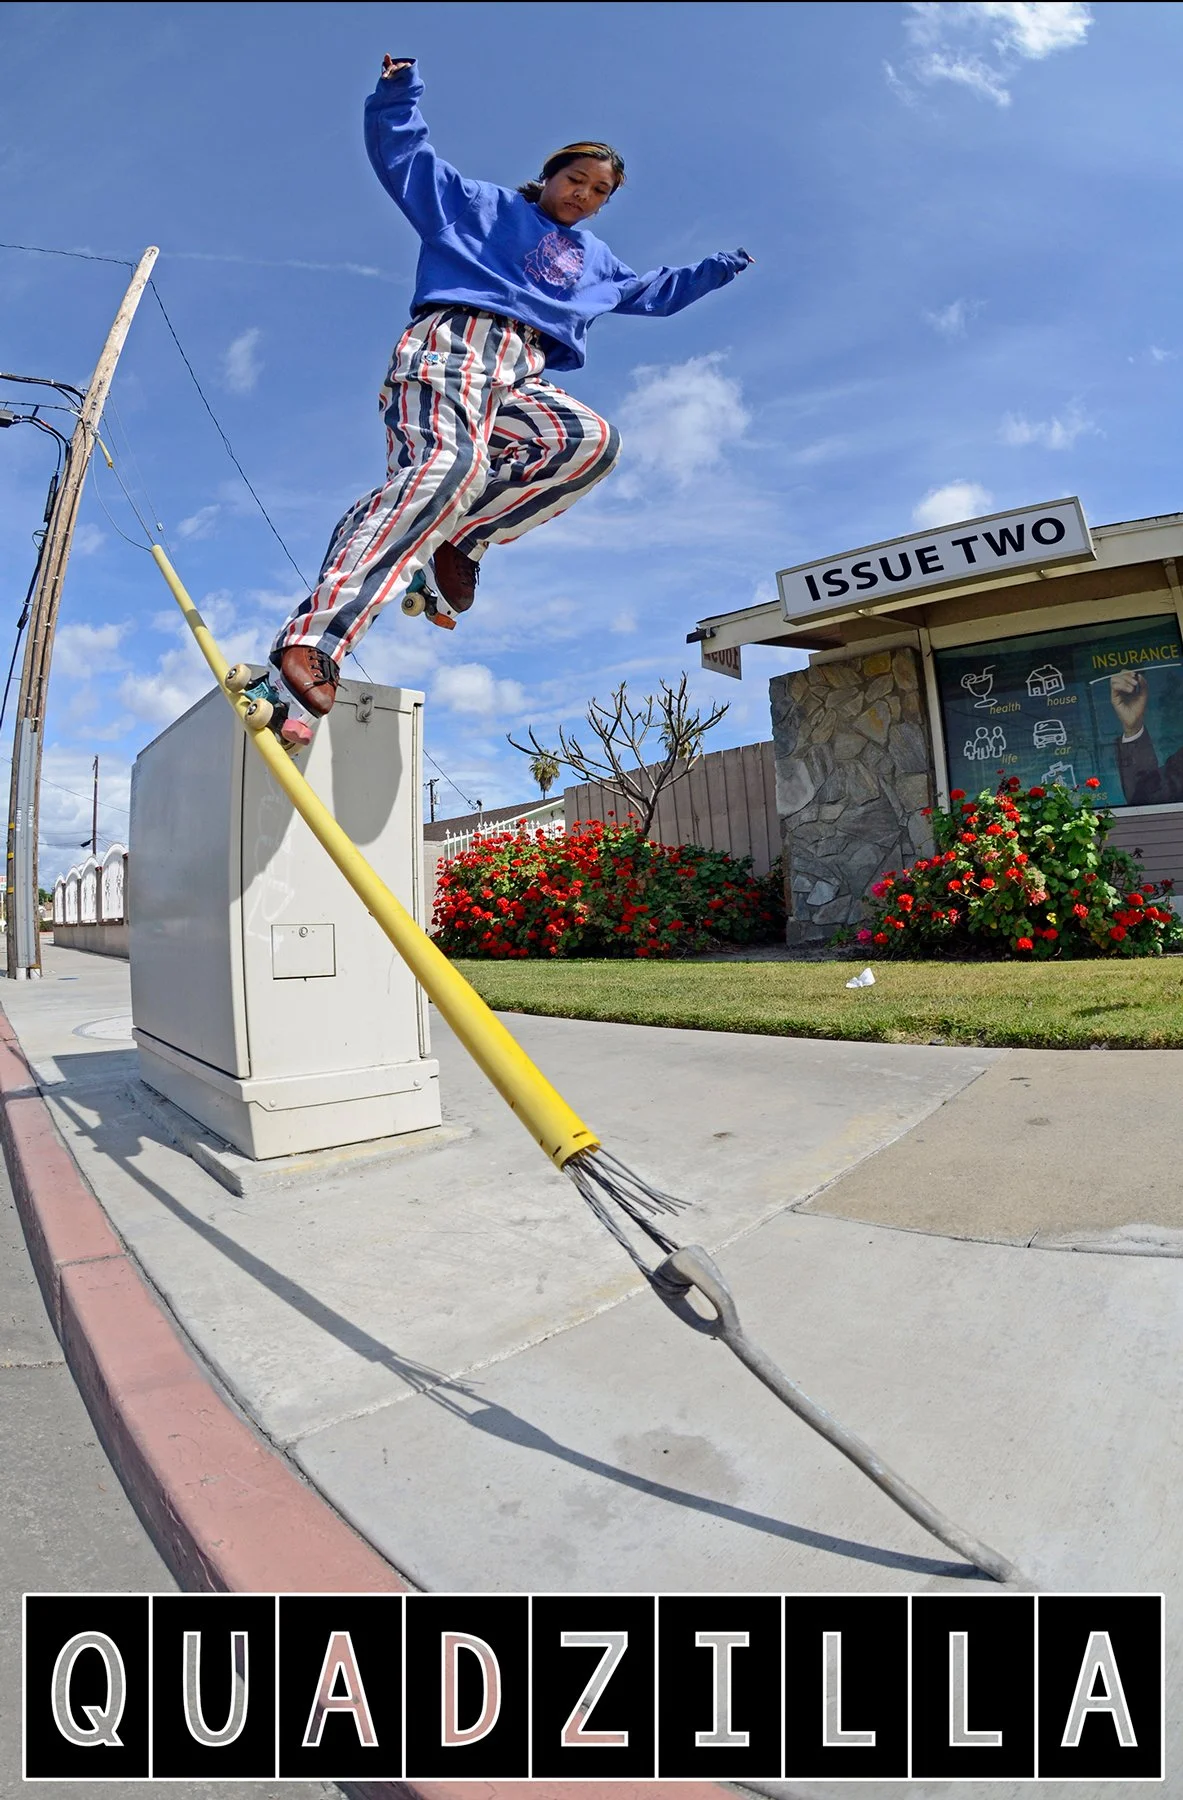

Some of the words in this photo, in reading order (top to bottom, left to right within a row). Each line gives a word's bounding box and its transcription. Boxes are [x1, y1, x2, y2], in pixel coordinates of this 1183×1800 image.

[804, 545, 944, 601] ISSUE
[951, 517, 1066, 564] TWO
[1092, 644, 1179, 669] INSURANCE
[1047, 695, 1078, 706] house
[989, 702, 1021, 715] health
[1054, 746, 1072, 756] car
[1001, 754, 1018, 765] life
